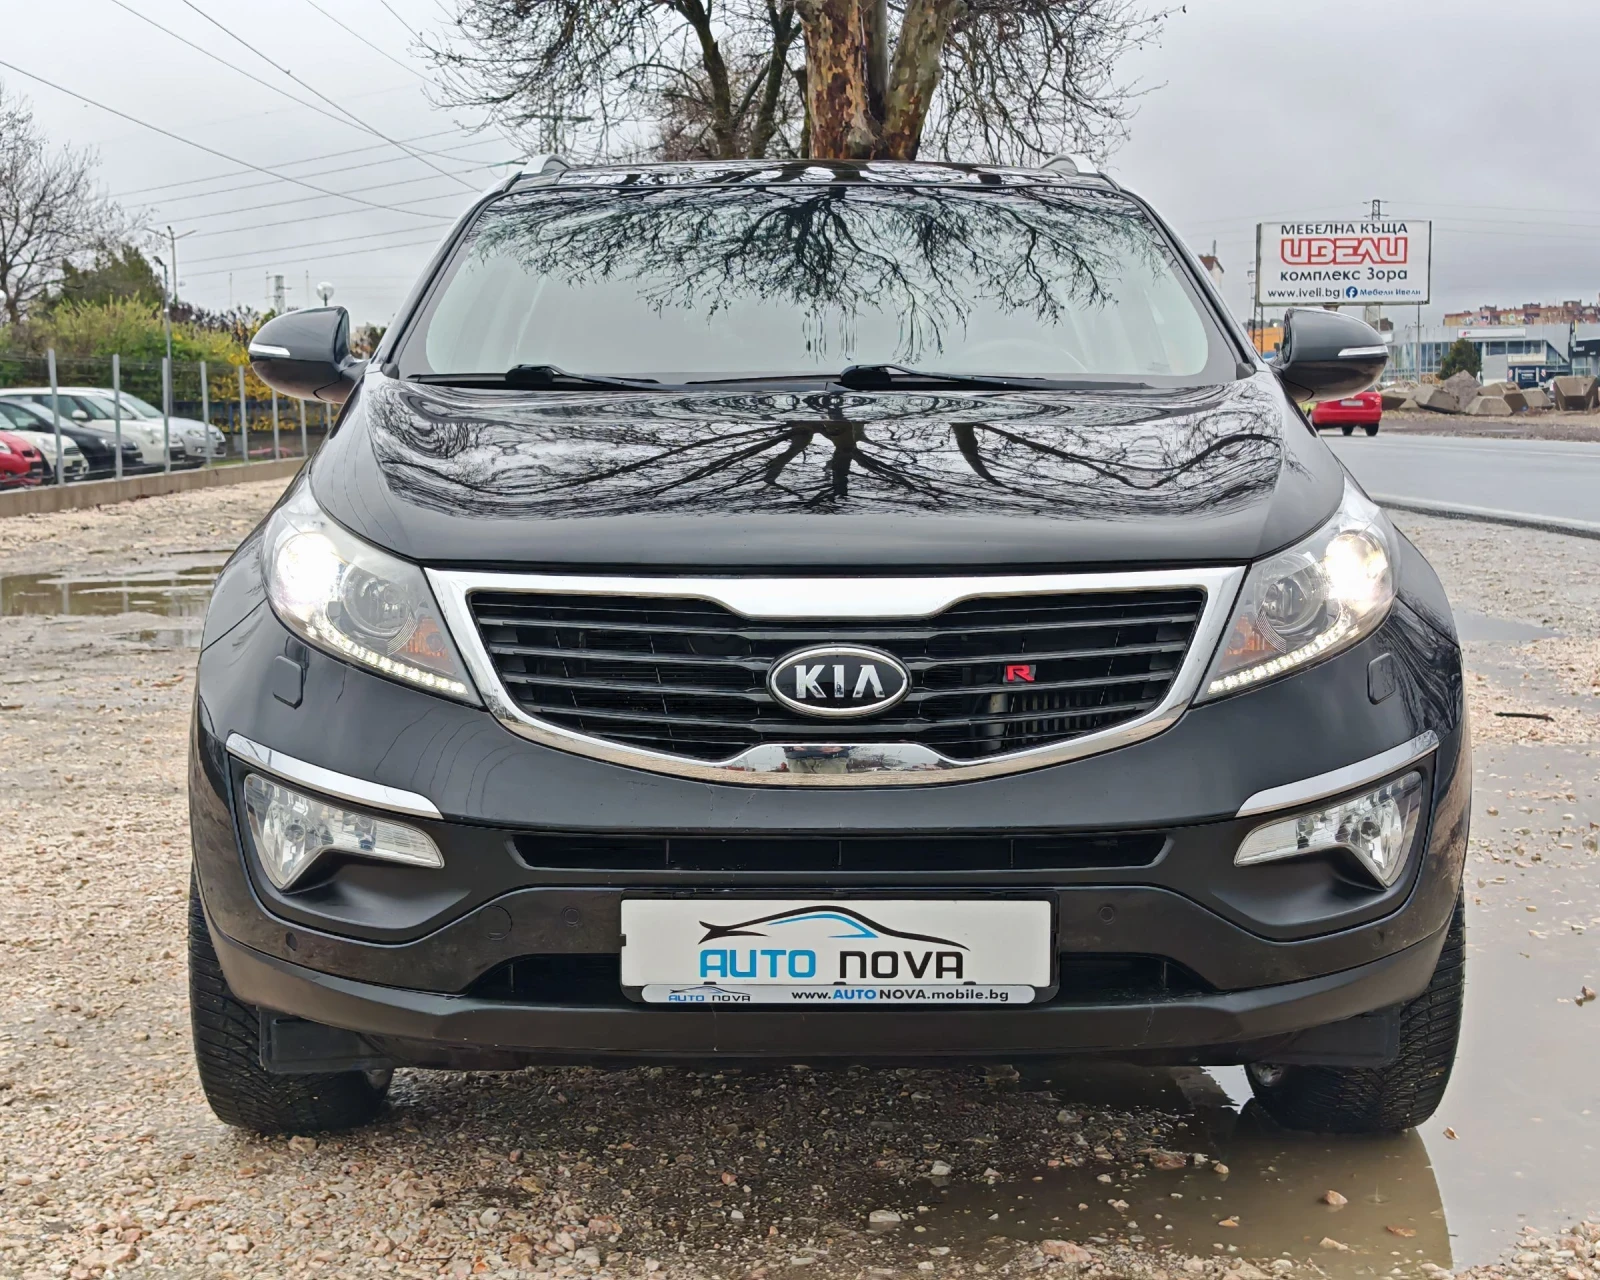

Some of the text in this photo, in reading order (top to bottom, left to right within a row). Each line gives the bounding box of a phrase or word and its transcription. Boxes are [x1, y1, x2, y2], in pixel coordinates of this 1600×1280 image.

[1281, 223, 1408, 235] МЕБЕЛНА КЪЩА
[1281, 237, 1408, 265] ИВЕЛИ
[1280, 267, 1408, 283] комплекс Зора
[1267, 288, 1341, 299] www.iveli.bg
[794, 664, 886, 699] KIA
[1005, 665, 1035, 683] R
[699, 949, 964, 979] AUTO NOVA
